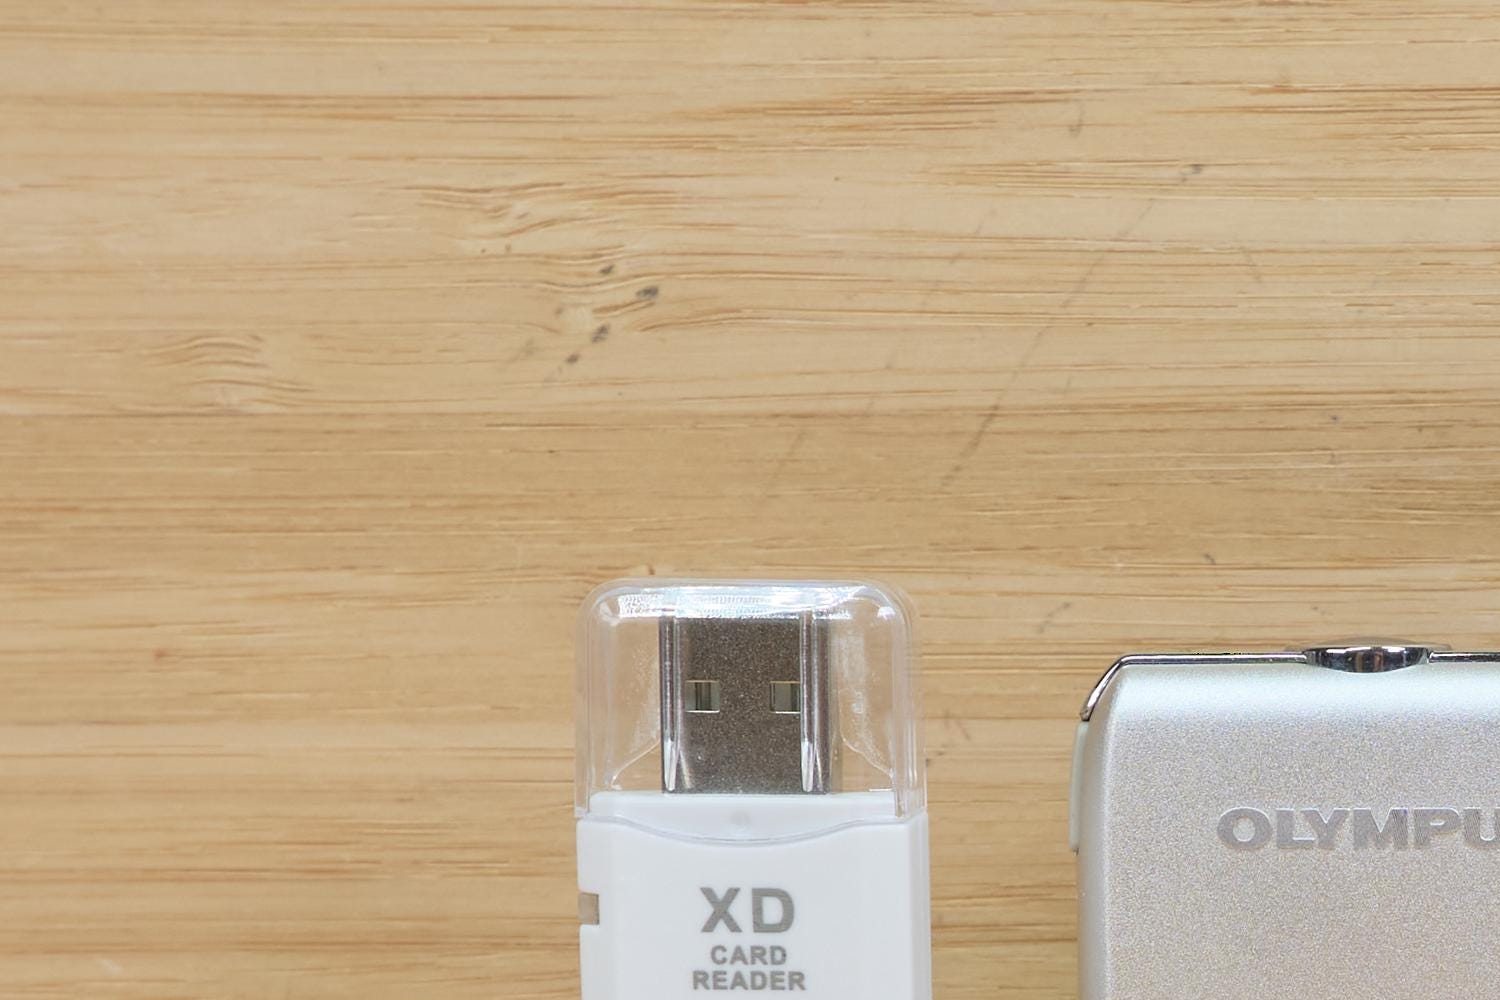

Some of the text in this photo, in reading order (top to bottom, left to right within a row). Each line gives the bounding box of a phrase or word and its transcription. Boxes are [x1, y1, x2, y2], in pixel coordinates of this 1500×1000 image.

[700, 887, 797, 934] XD
[711, 945, 788, 967] CARD
[692, 970, 808, 992] READER
